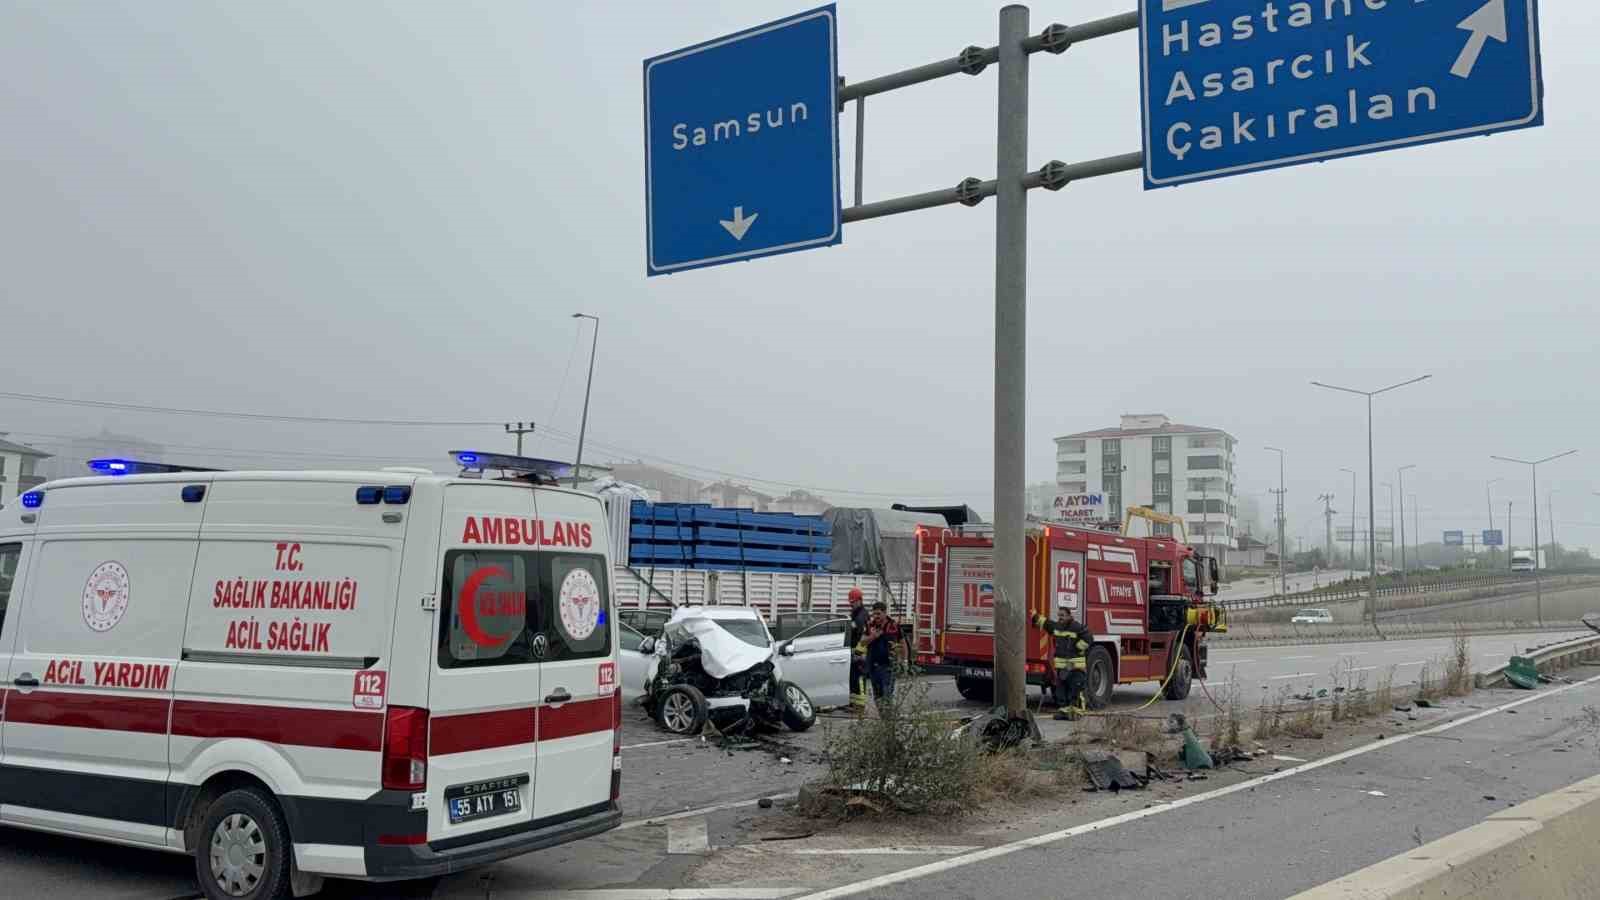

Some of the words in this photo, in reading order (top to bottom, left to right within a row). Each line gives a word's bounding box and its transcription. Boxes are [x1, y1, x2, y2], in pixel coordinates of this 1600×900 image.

[1165, 35, 1374, 105] Asarcık
[672, 101, 808, 150] Samsun
[1165, 85, 1437, 161] Çakıralan
[462, 516, 593, 548] AMBULANS
[274, 542, 304, 571] T.C.
[1060, 566, 1076, 590] 112
[213, 576, 268, 609] SAĞLIK
[269, 576, 358, 610] BAKANLIĞI
[225, 616, 262, 650] ACİL
[266, 617, 332, 652] SAĞLIK
[93, 661, 171, 690] YARDIM
[359, 674, 382, 694] 112
[600, 666, 613, 683] 112
[463, 778, 519, 795] CRAFTER
[457, 798, 471, 816] 55
[476, 794, 495, 813] ATY
[502, 790, 519, 809] 151
